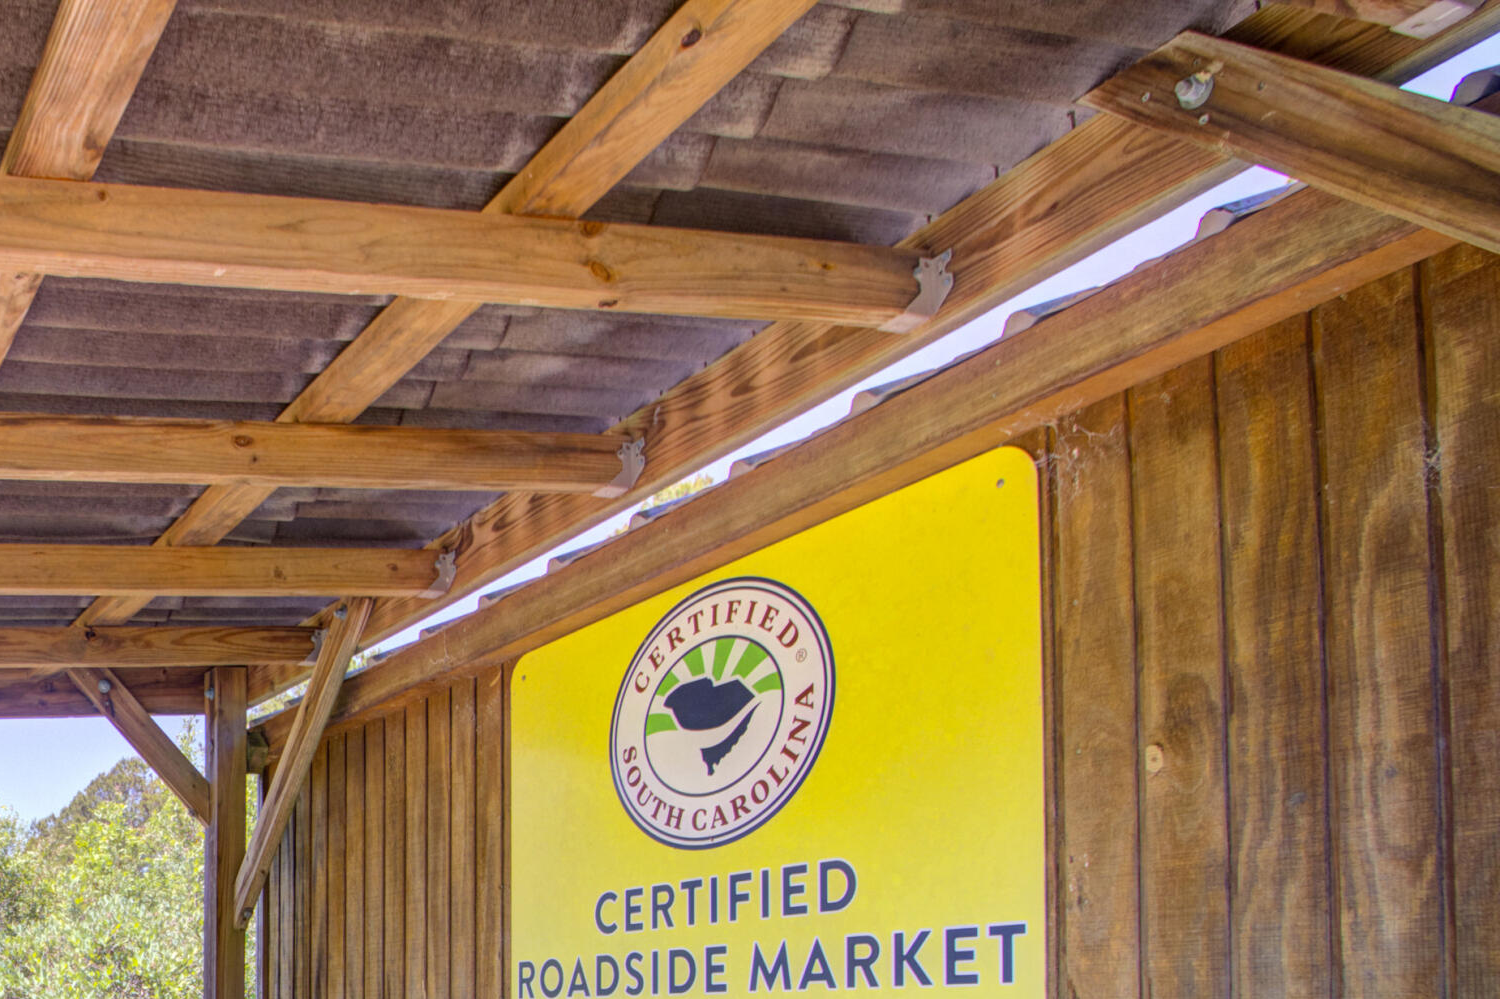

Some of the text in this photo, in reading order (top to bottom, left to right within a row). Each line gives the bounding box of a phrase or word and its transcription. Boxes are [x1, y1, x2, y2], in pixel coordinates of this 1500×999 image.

[634, 600, 799, 694] CERTIFIED
[623, 682, 815, 831] SOUTH CAROLINA
[595, 859, 857, 935] CERTIFIED
[517, 921, 1027, 999] ROADSIDE MARKET
